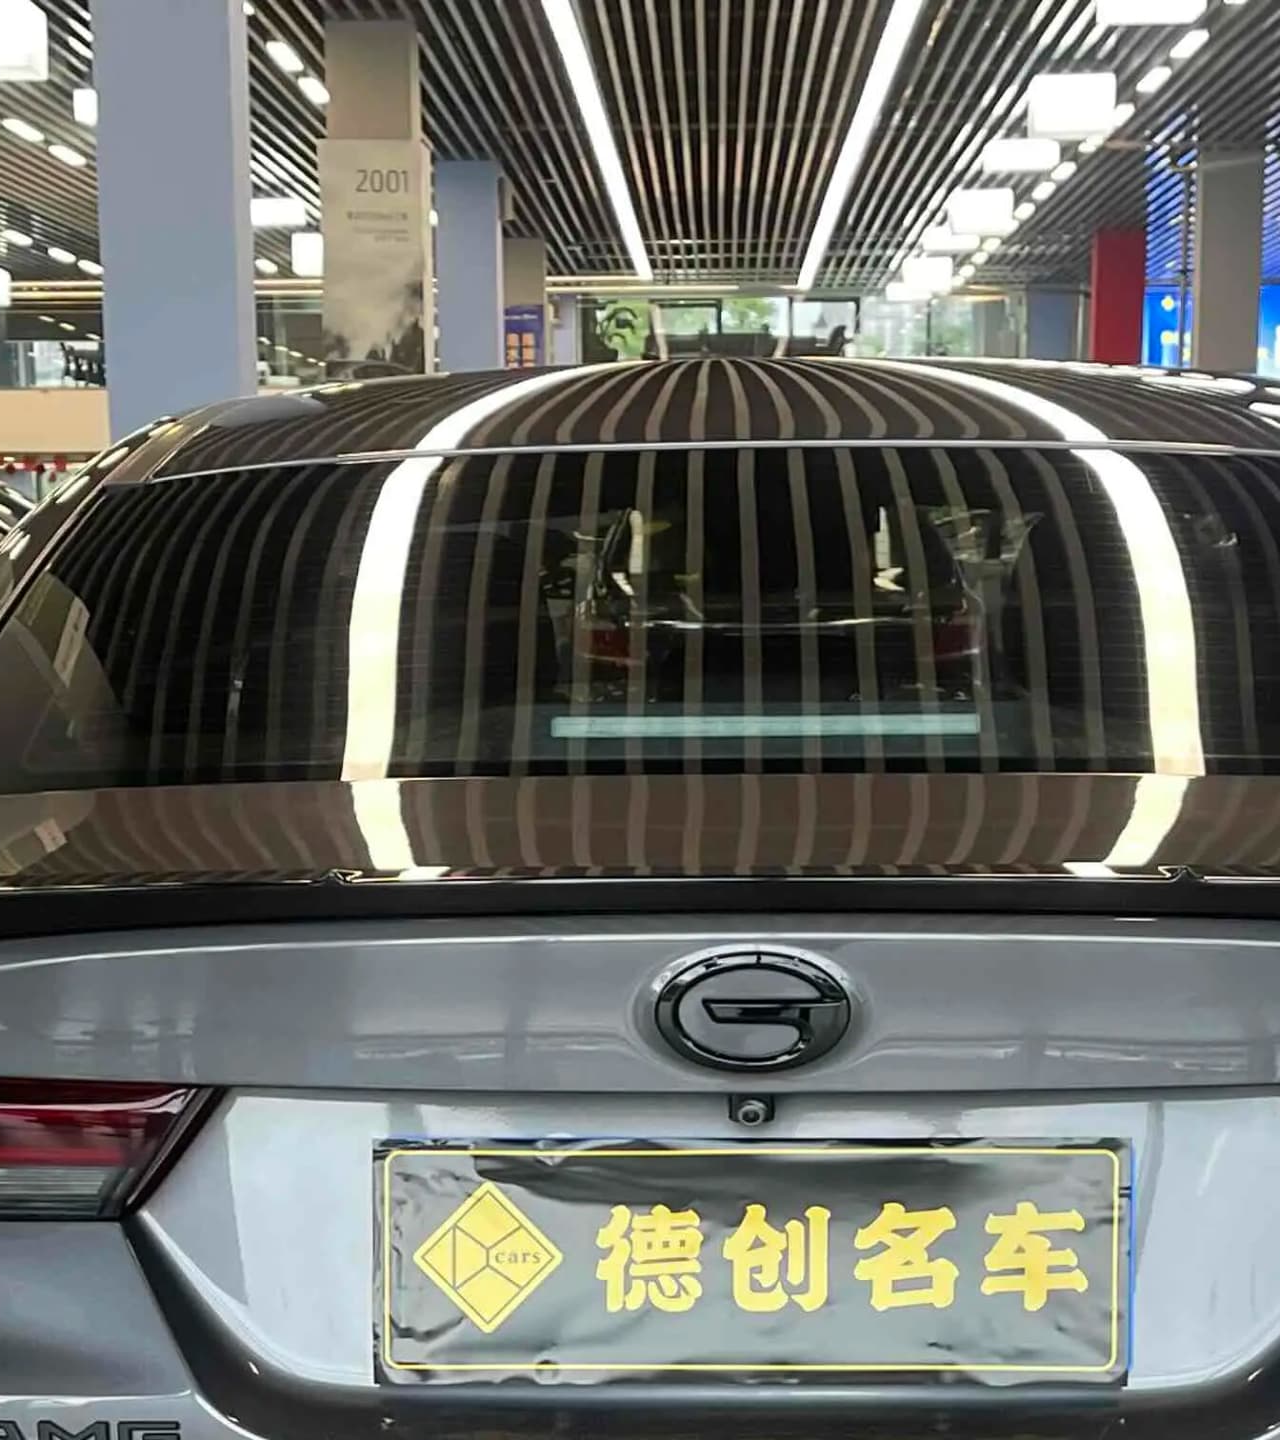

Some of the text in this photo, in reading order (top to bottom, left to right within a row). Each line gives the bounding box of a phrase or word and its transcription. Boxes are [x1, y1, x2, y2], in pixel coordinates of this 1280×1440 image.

[355, 169, 409, 193] 2001
[494, 1251, 541, 1264] cars
[596, 1201, 1088, 1314] 德创名车
